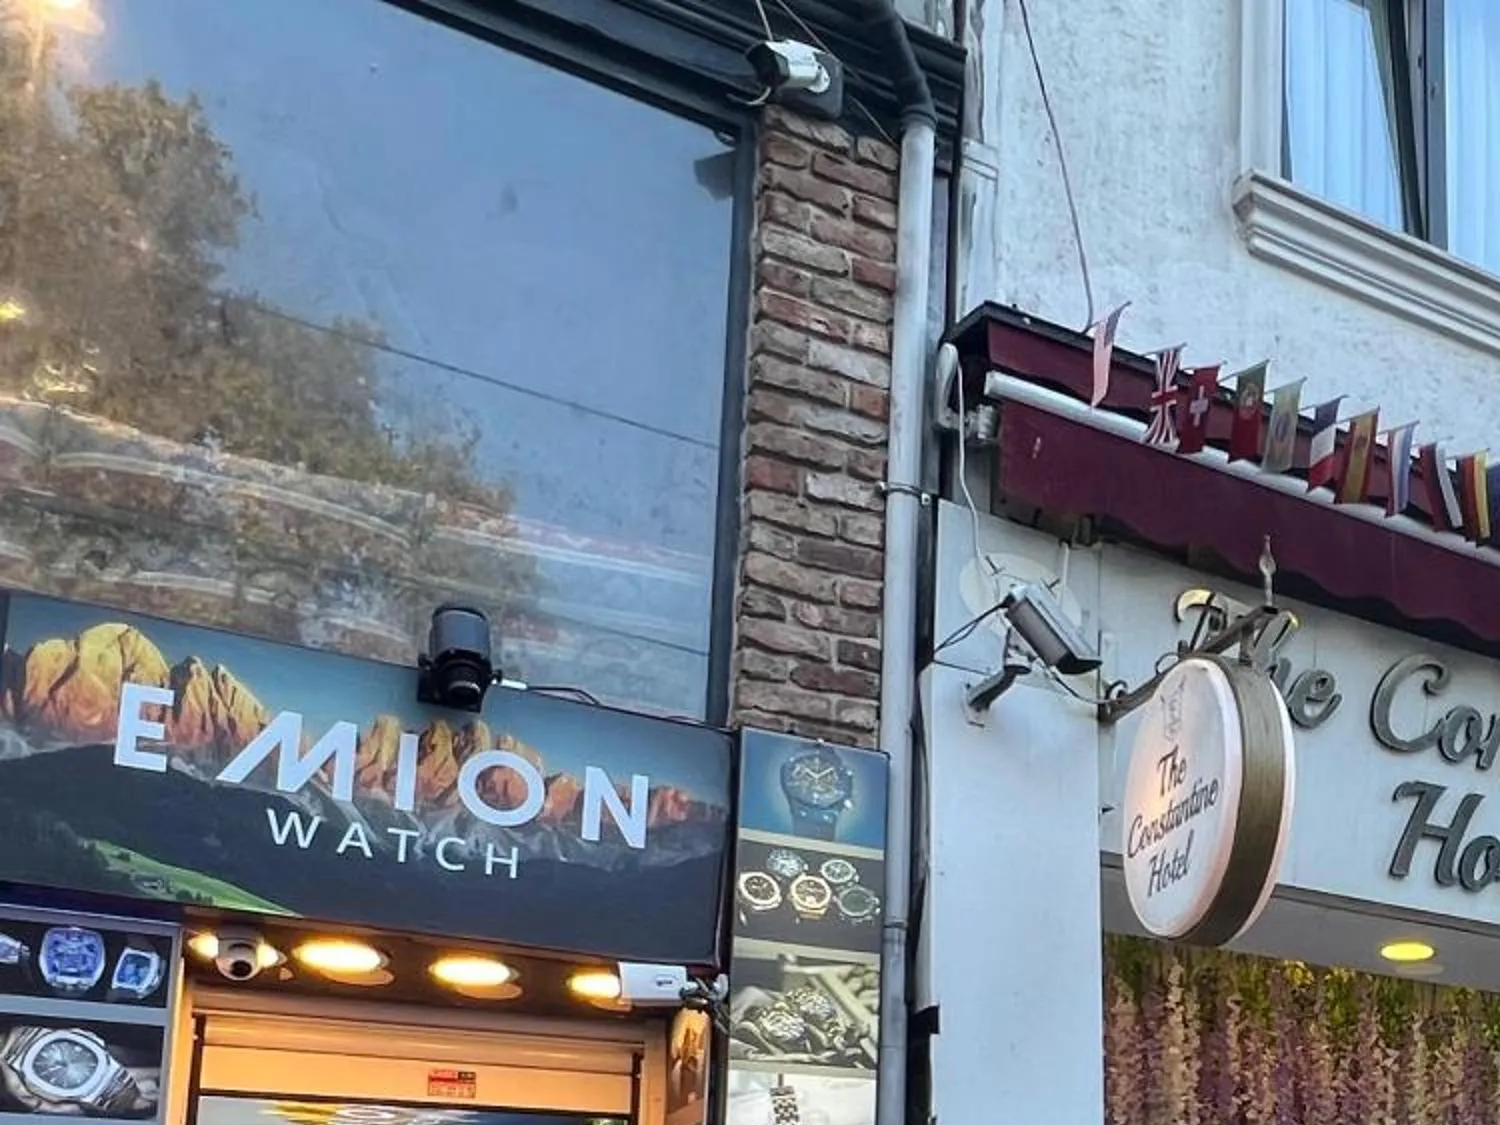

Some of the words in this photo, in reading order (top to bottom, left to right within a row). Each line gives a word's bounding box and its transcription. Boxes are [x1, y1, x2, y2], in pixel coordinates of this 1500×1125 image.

[113, 682, 649, 849] EMION
[1156, 745, 1188, 798] The
[266, 808, 520, 879] WATCH
[1126, 776, 1220, 860] Constantine
[1147, 829, 1195, 898] Hotel
